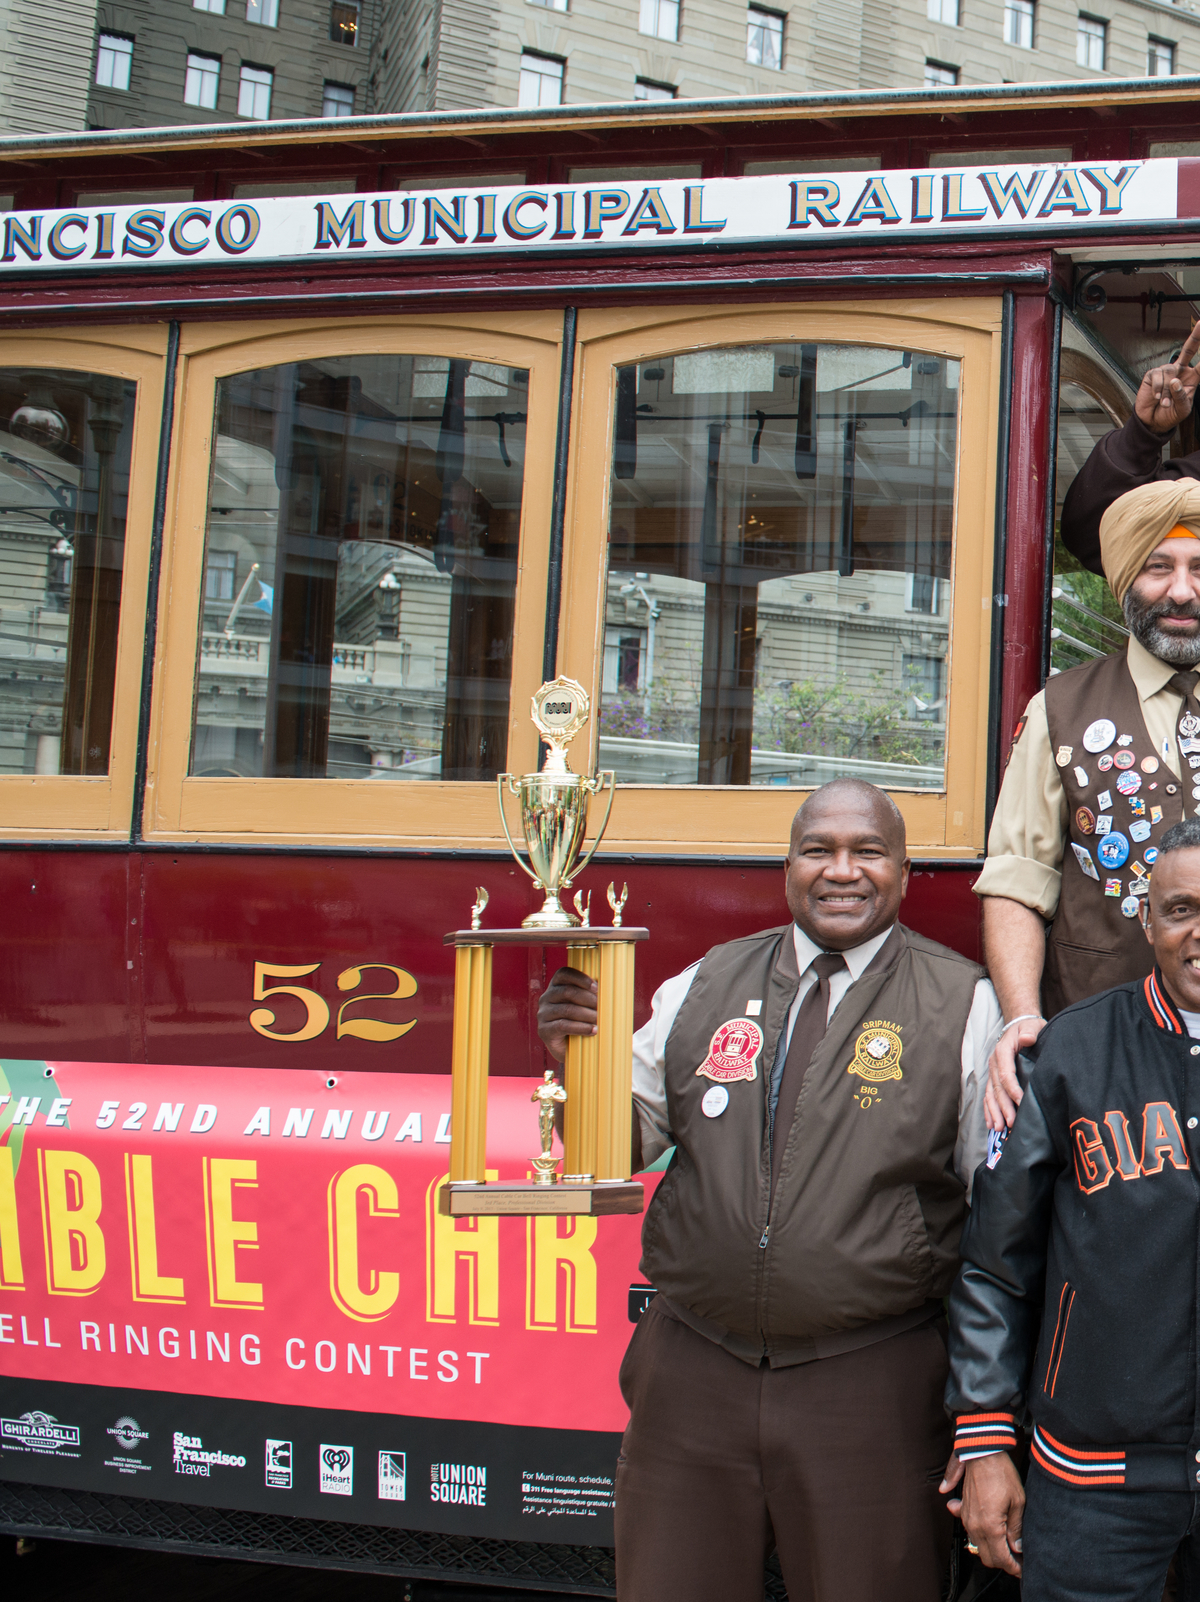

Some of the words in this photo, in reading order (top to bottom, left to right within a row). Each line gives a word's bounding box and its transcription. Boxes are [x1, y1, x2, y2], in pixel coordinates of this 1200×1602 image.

[314, 184, 728, 251] MUNICIPAL
[786, 165, 1140, 230] RAILWAY
[249, 960, 419, 1043] 52
[862, 1020, 903, 1034] GRIPMAN
[726, 1022, 760, 1050] MUNICIPAL
[714, 1051, 749, 1067] RAILWAY
[860, 1051, 893, 1066] RAILWAY
[715, 1069, 727, 1078] CAR
[860, 1085, 878, 1095] BIG
[95, 1101, 218, 1133] 52ND
[327, 1163, 598, 1335] CAR
[80, 1321, 262, 1366] RINGING
[285, 1338, 491, 1385] CONTEST
[4, 1423, 77, 1441] GHIRARDELLI
[106, 1427, 126, 1437] UNION
[126, 1429, 149, 1439] SQUARE
[173, 1432, 202, 1449] San
[173, 1445, 247, 1467] Francisco
[322, 1473, 351, 1484] iHeart
[431, 1463, 439, 1482] HOTEL
[440, 1463, 487, 1486] UNION
[522, 1471, 535, 1480] For
[535, 1472, 555, 1481] Muni
[555, 1475, 578, 1483] route,
[579, 1476, 614, 1486] schedule,
[322, 1481, 351, 1493] RADIO
[381, 1483, 404, 1493] TOWER
[430, 1482, 487, 1506] SQUARE
[554, 1487, 580, 1495] language
[581, 1489, 610, 1497] assistance
[522, 1496, 552, 1504] Assistance
[553, 1497, 586, 1506] linguistique
